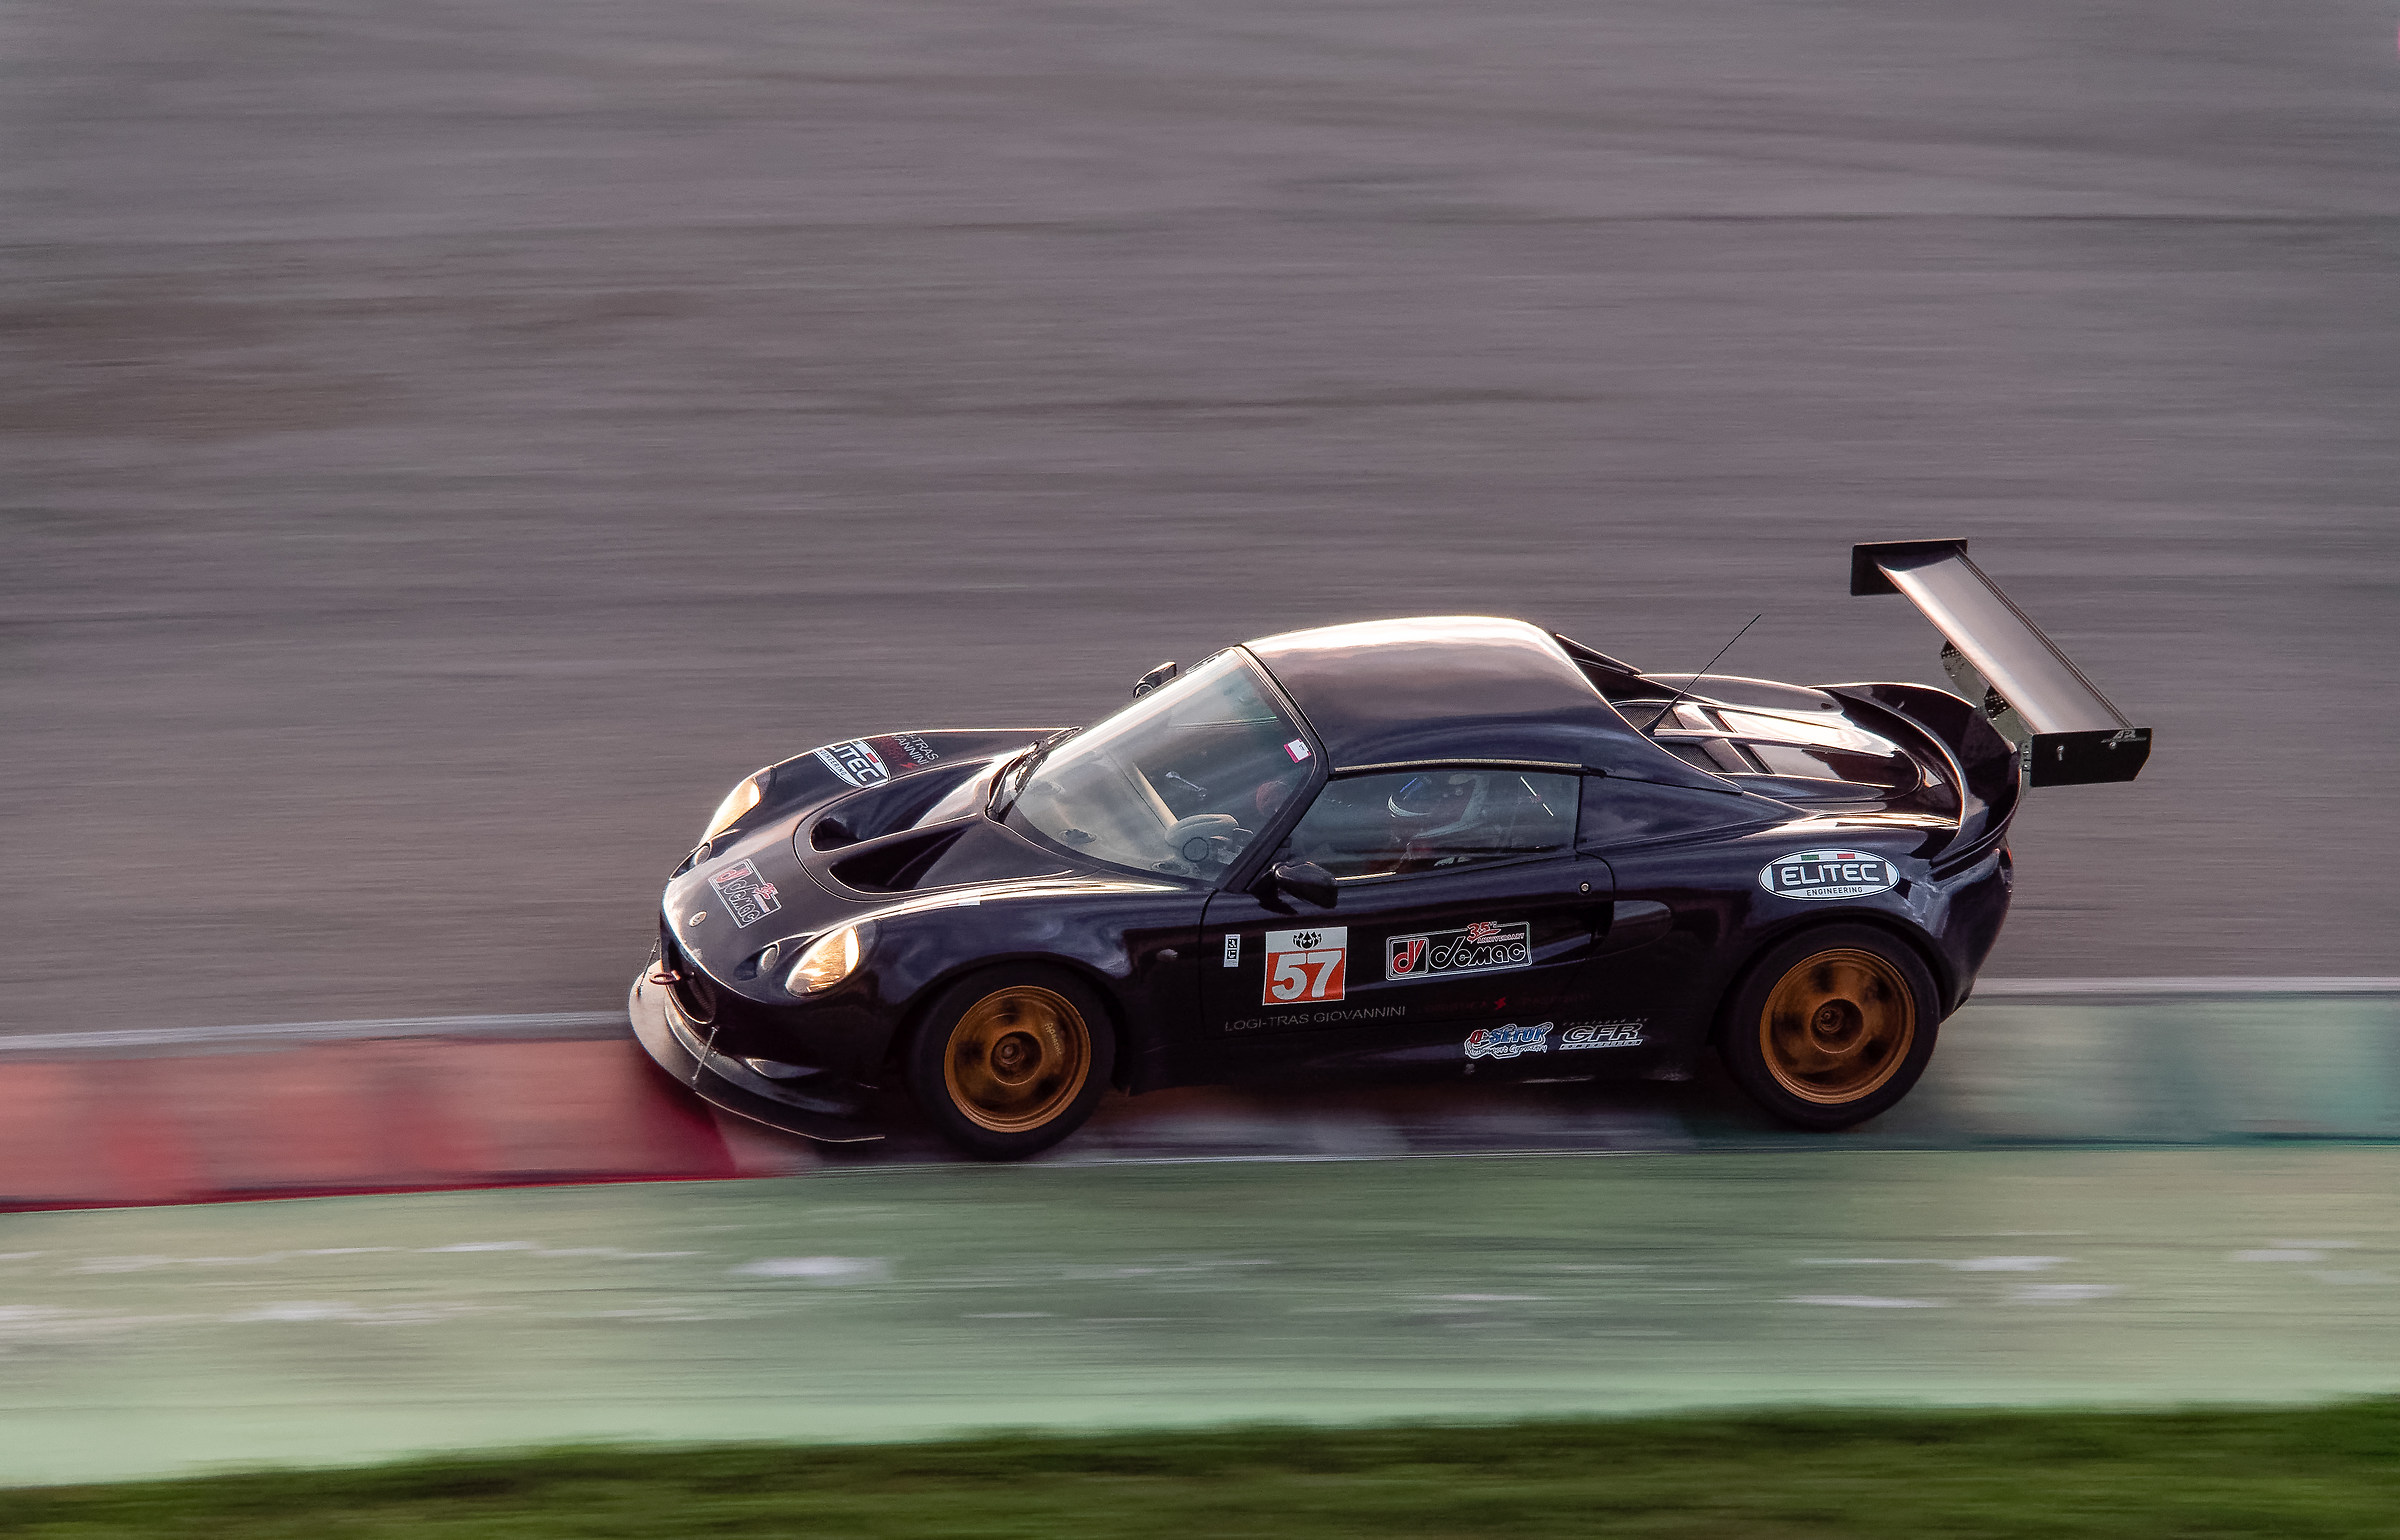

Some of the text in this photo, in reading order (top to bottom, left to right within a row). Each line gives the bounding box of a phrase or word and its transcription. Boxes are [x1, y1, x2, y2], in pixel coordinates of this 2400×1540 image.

[1781, 864, 1880, 886] ELITEC
[1806, 886, 1863, 897] ENGINEERING
[1271, 950, 1343, 1001] 57
[1225, 1013, 1309, 1032] LOGI-TRAS
[1313, 1005, 1406, 1023] GIOVANNINI
[1561, 1022, 1644, 1043] GFR
